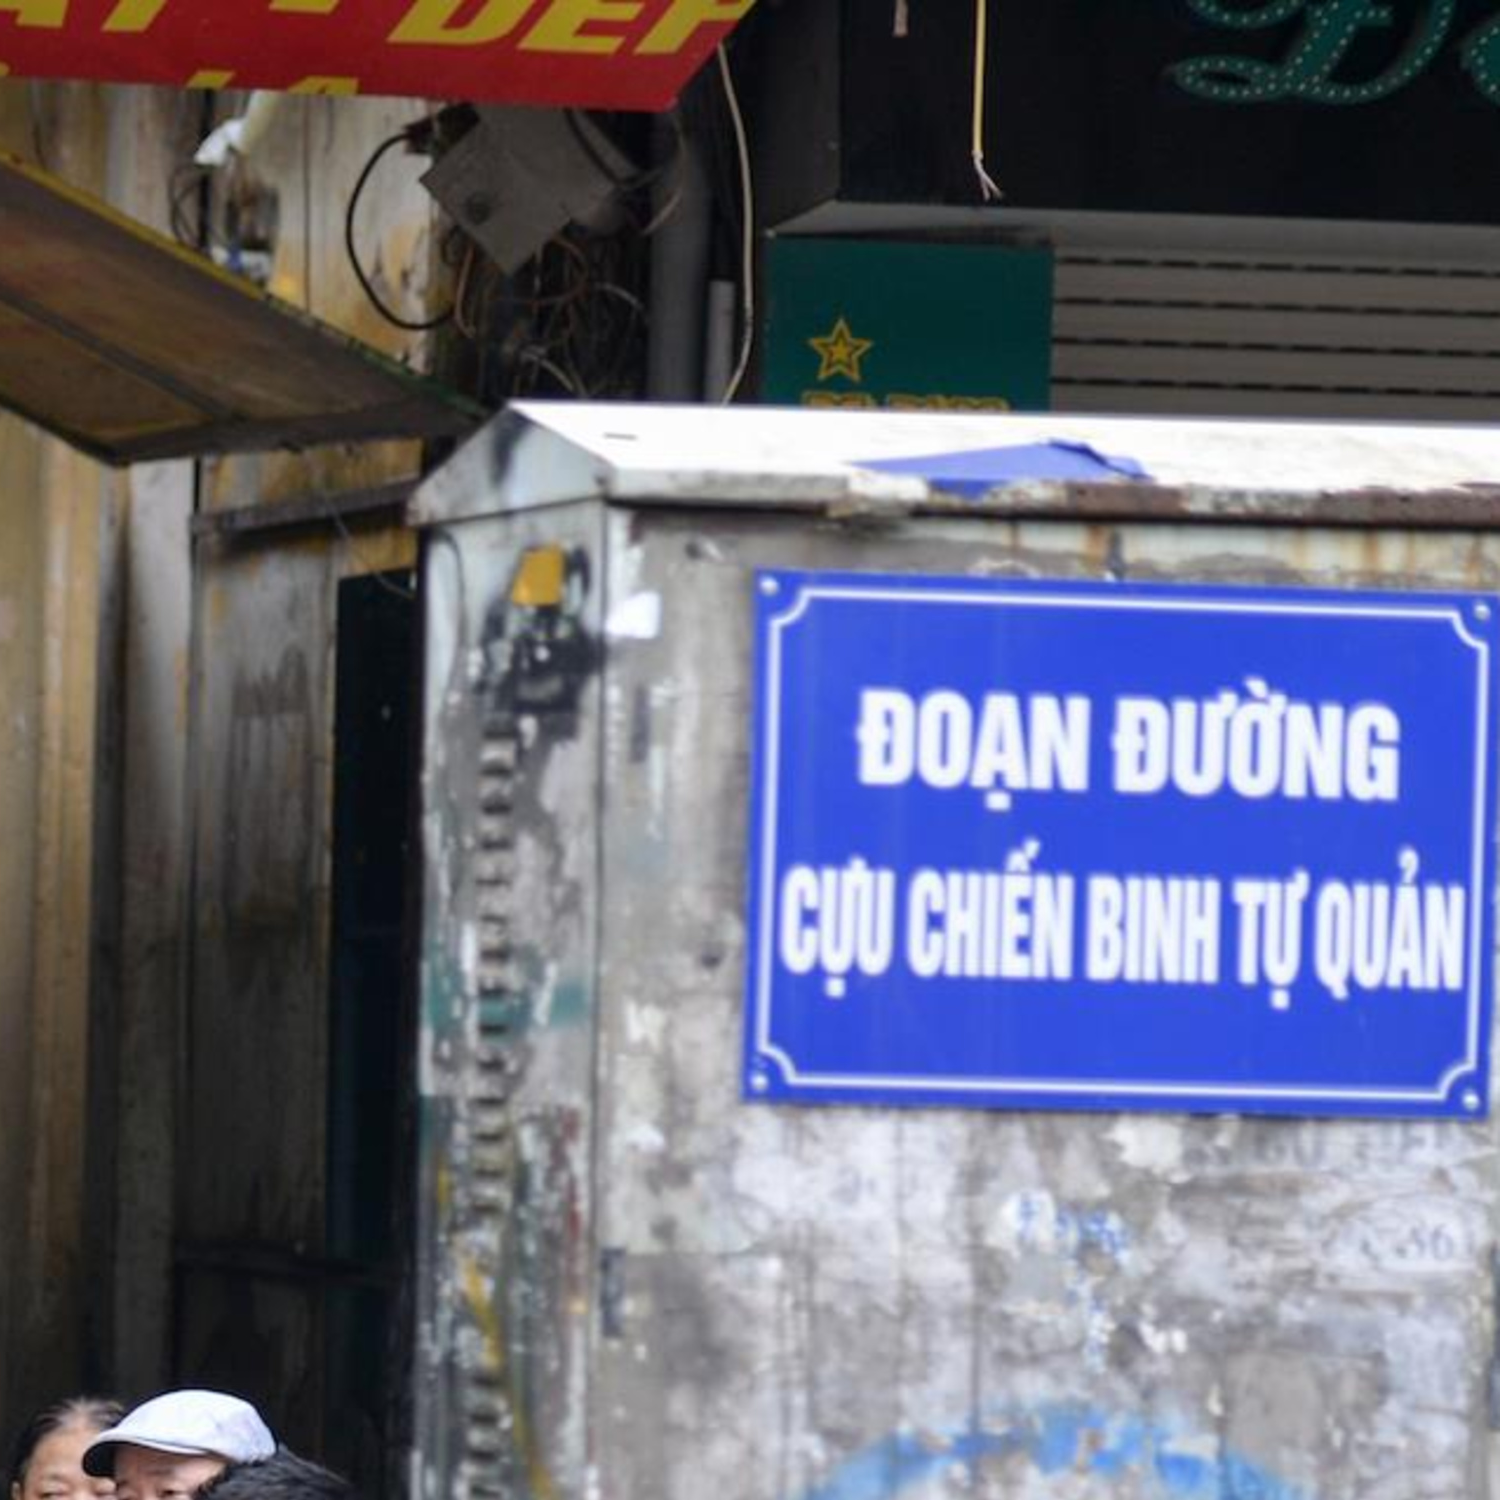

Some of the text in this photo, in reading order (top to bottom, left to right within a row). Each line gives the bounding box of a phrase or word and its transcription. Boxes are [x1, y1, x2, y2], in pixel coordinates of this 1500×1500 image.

[855, 676, 1401, 812] ĐOẠN ĐƯỜNG
[778, 838, 1467, 1011] CỰU CHIẾN BINH TỰ QUẢN
